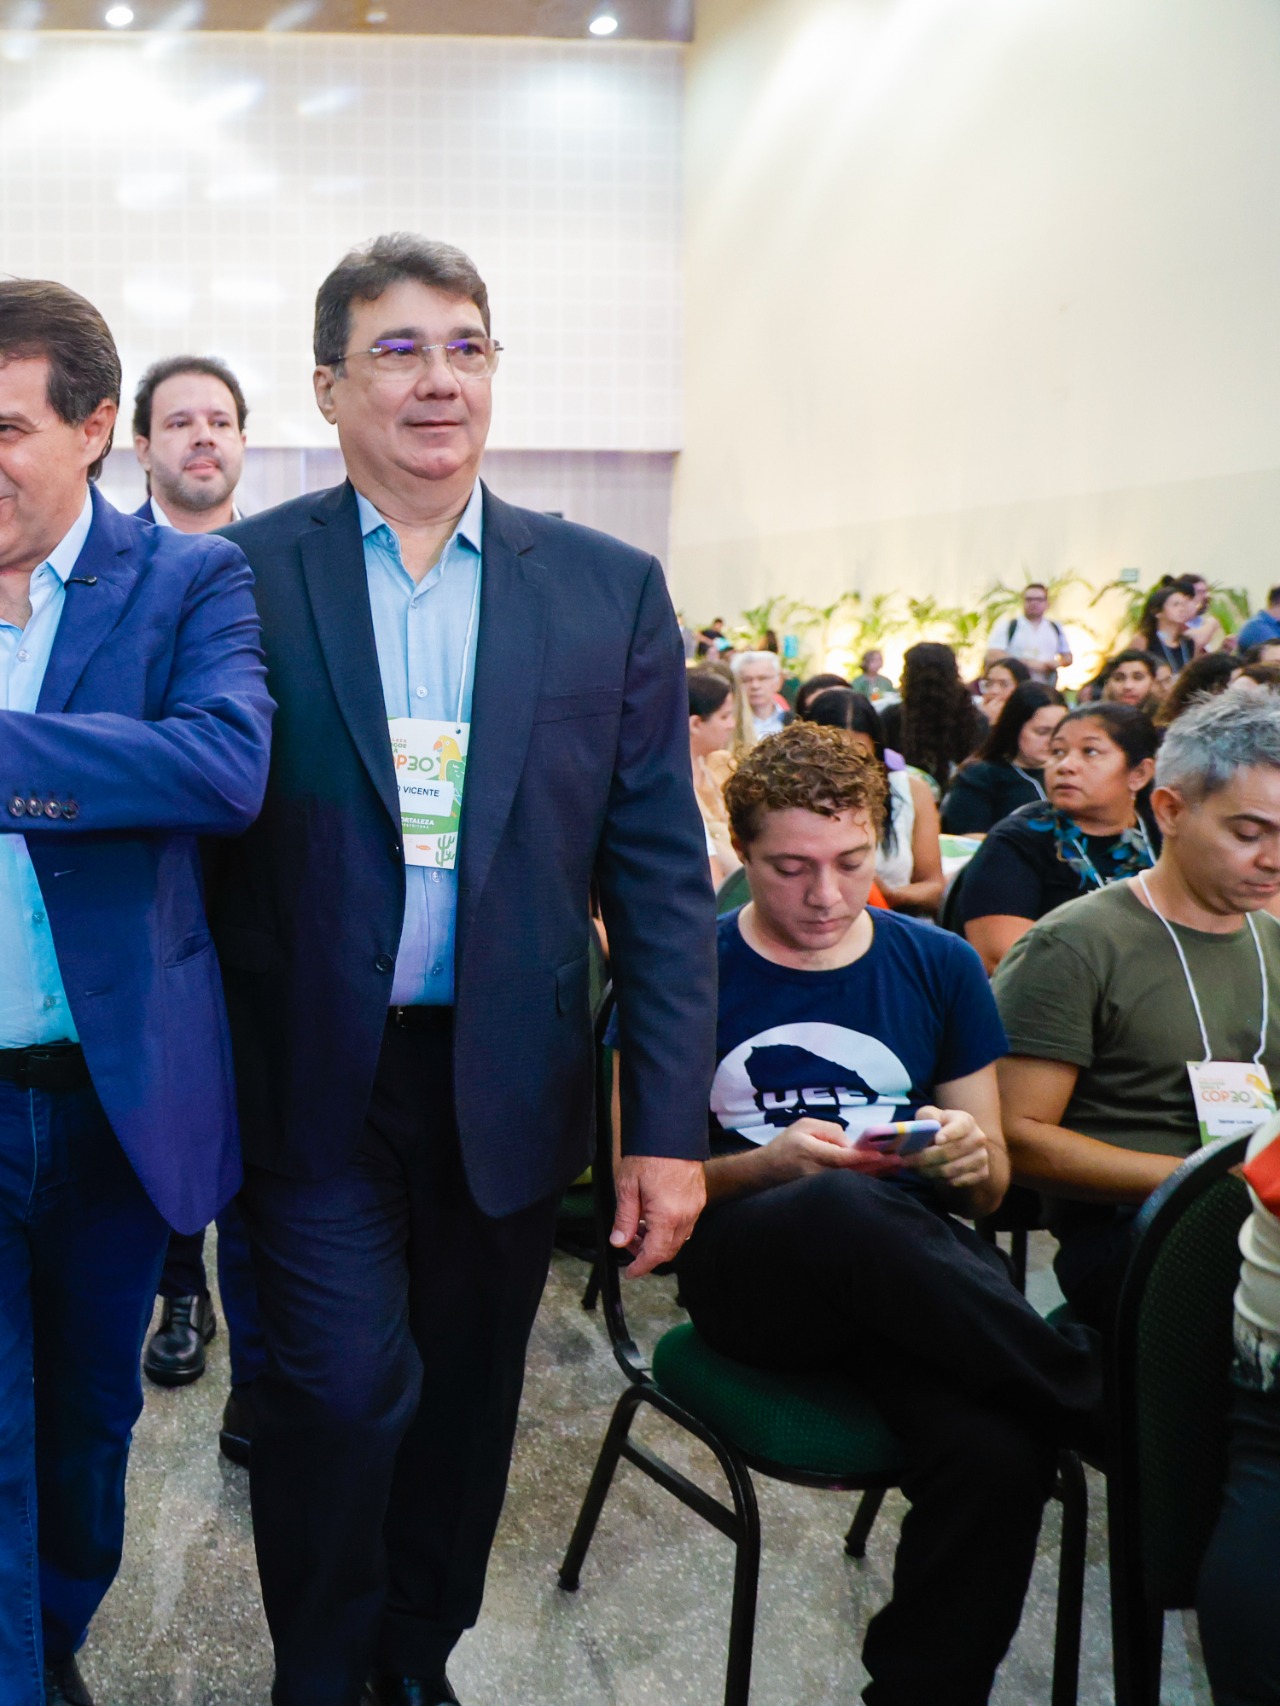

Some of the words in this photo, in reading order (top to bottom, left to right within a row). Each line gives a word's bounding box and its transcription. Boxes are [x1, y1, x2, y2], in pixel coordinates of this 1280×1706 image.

[393, 755, 434, 772] P30
[403, 786, 440, 797] VICENTE
[401, 816, 435, 826] ORTALEZA
[1200, 1089, 1251, 1103] COP30
